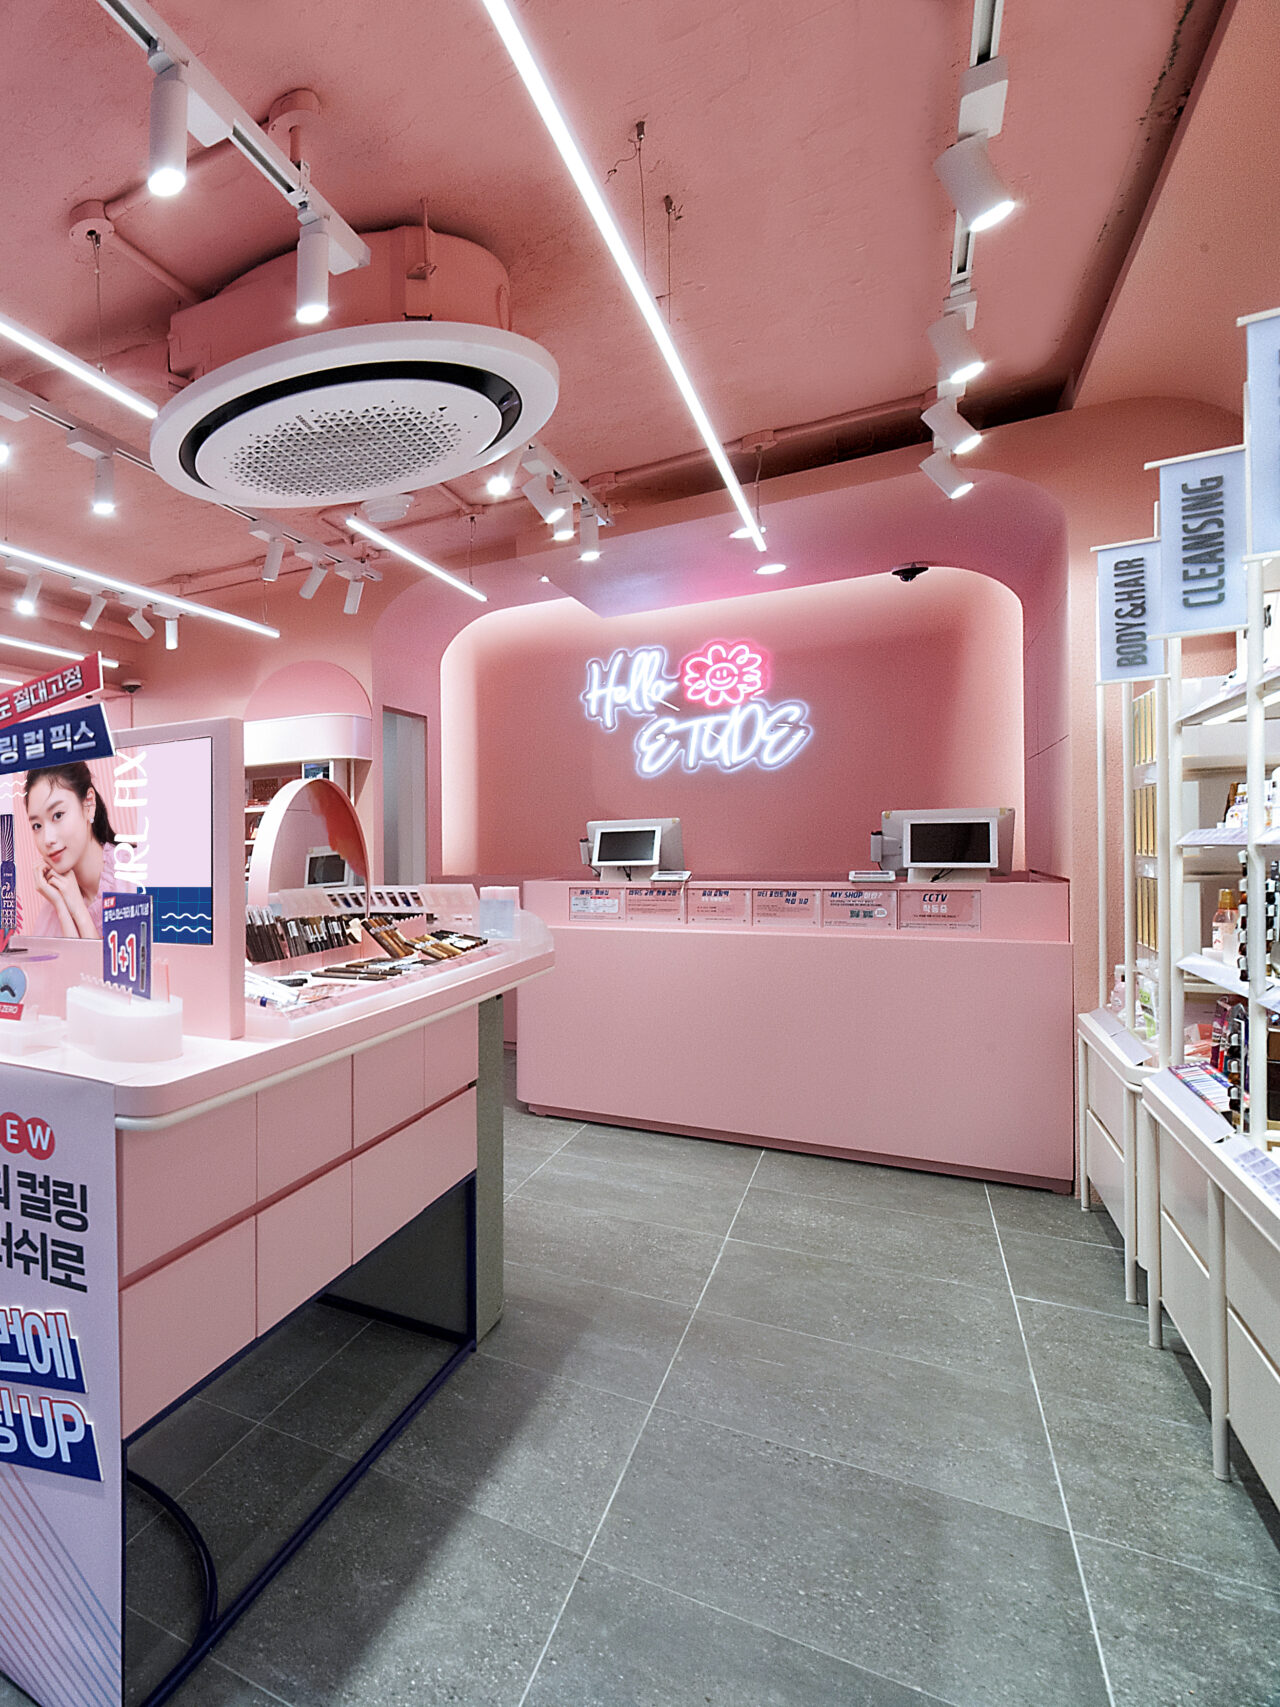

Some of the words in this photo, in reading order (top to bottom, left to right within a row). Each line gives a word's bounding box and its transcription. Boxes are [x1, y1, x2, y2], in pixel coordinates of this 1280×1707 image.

[1181, 475, 1225, 609] CLEANSING
[1113, 557, 1148, 668] BODY&HAIR
[13, 664, 84, 713] 절대고정
[586, 650, 679, 729] Hello
[23, 729, 46, 760] 컬
[49, 720, 97, 753] 픽스
[639, 703, 807, 773] ETUDE
[830, 891, 841, 899] MY
[922, 893, 948, 903] CCTV
[108, 930, 137, 982] 1+1
[16, 1170, 89, 1232] 컬링
